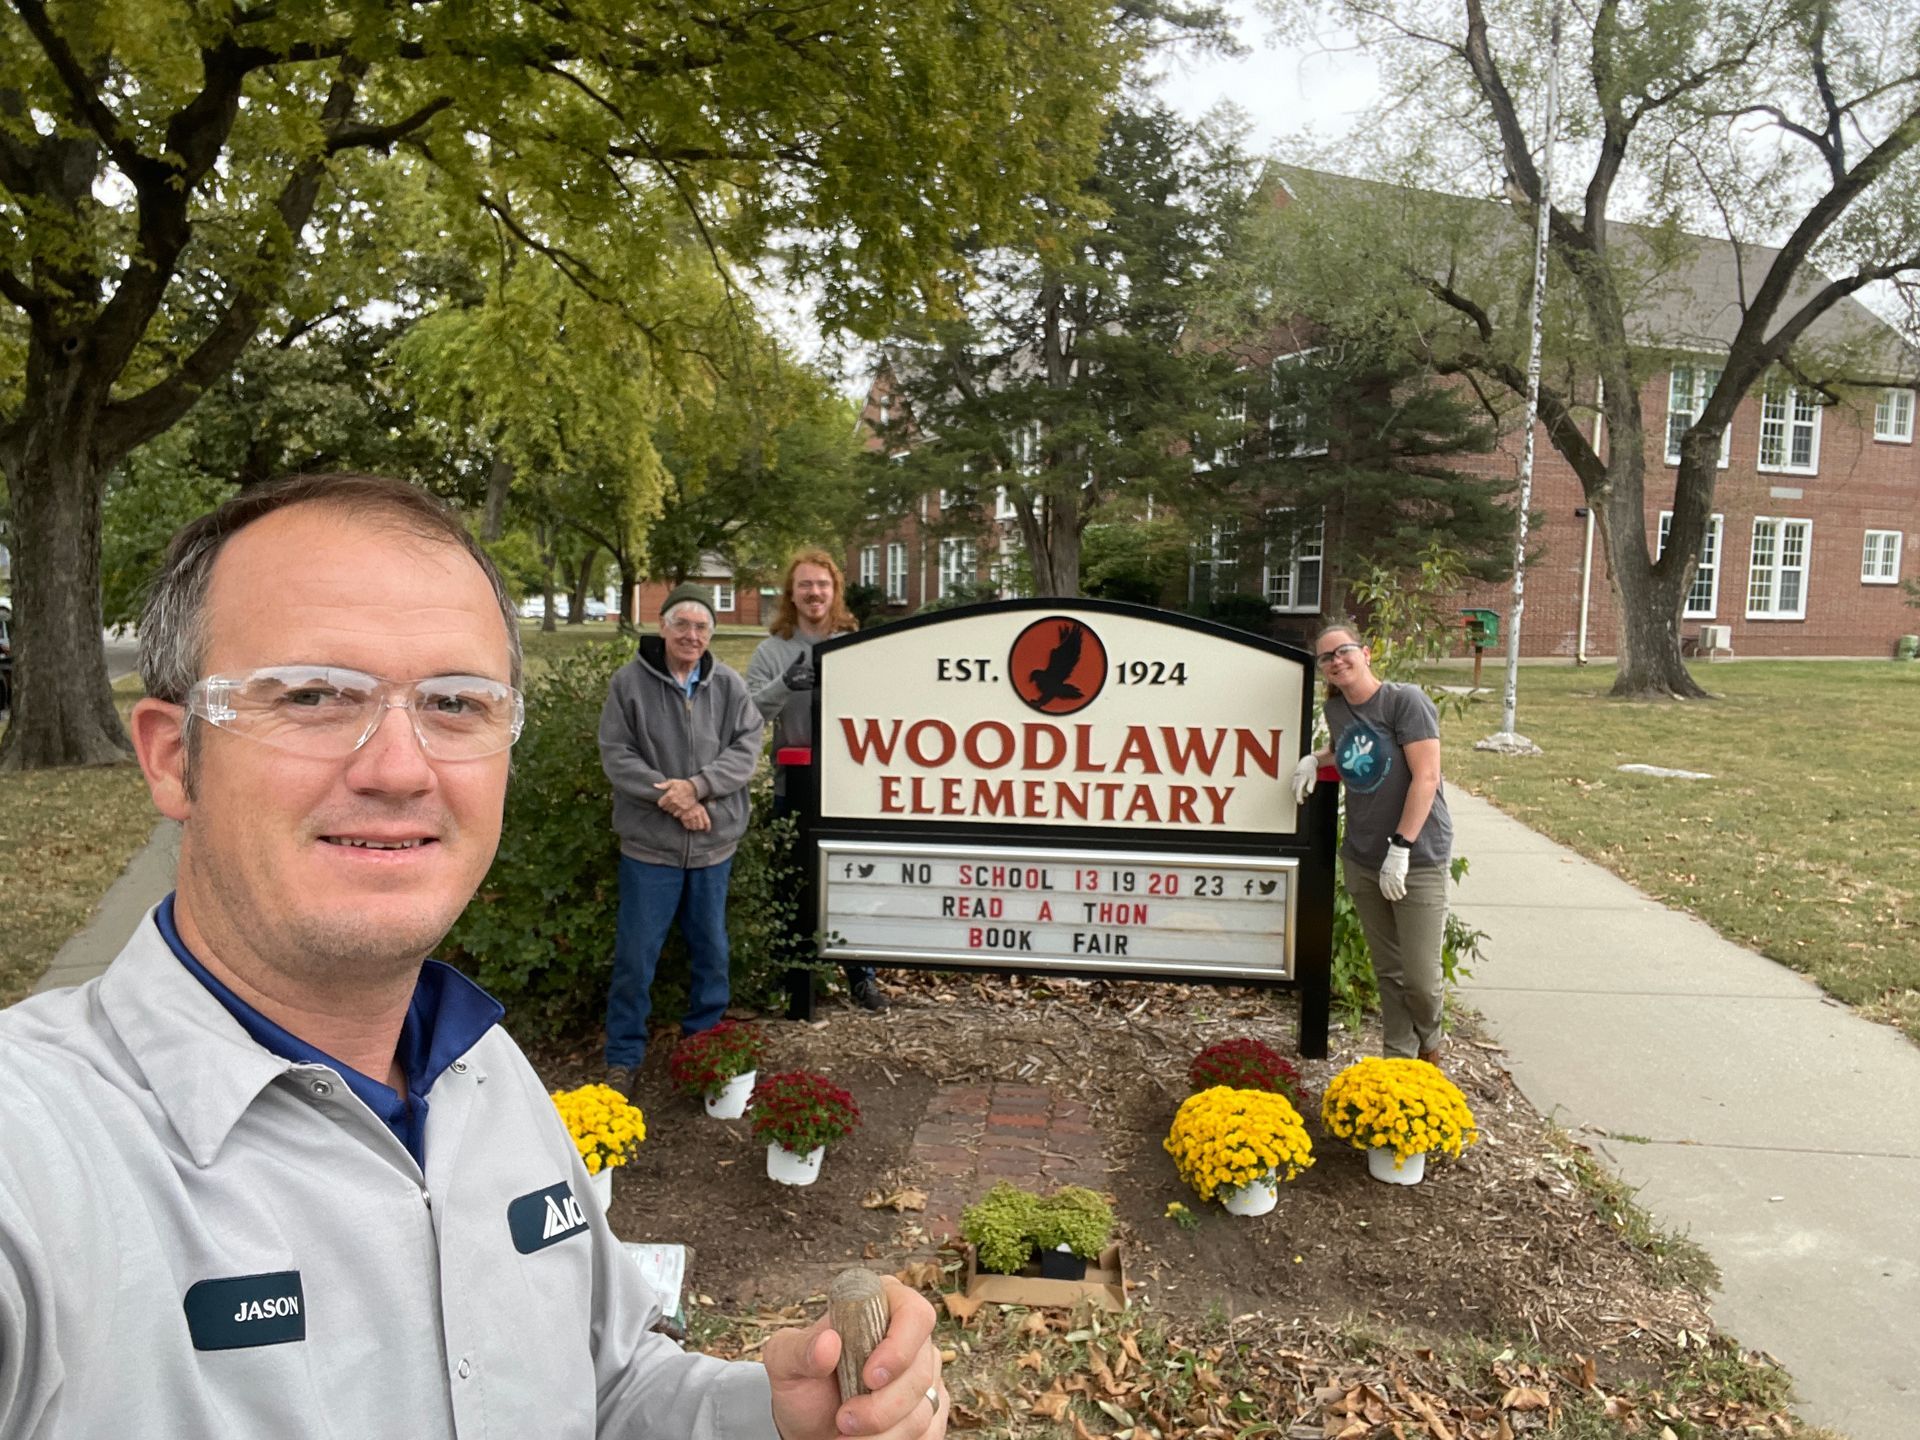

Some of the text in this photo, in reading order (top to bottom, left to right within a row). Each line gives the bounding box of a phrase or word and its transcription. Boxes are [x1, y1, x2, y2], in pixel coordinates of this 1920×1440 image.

[937, 658, 1188, 686] EST. 1924
[839, 718, 1283, 779] WOODLAWN
[880, 776, 1234, 825] ELEMENTARY
[902, 863, 931, 884] NO
[959, 865, 1053, 889] SCHOOL
[1075, 870, 1098, 890] 13
[1113, 872, 1135, 892] 19
[1148, 874, 1179, 895] 20
[1194, 876, 1223, 896] 23
[942, 896, 1147, 925] READ A THON
[969, 927, 1128, 955] BOOK FAIR
[234, 1296, 299, 1322] JASON
